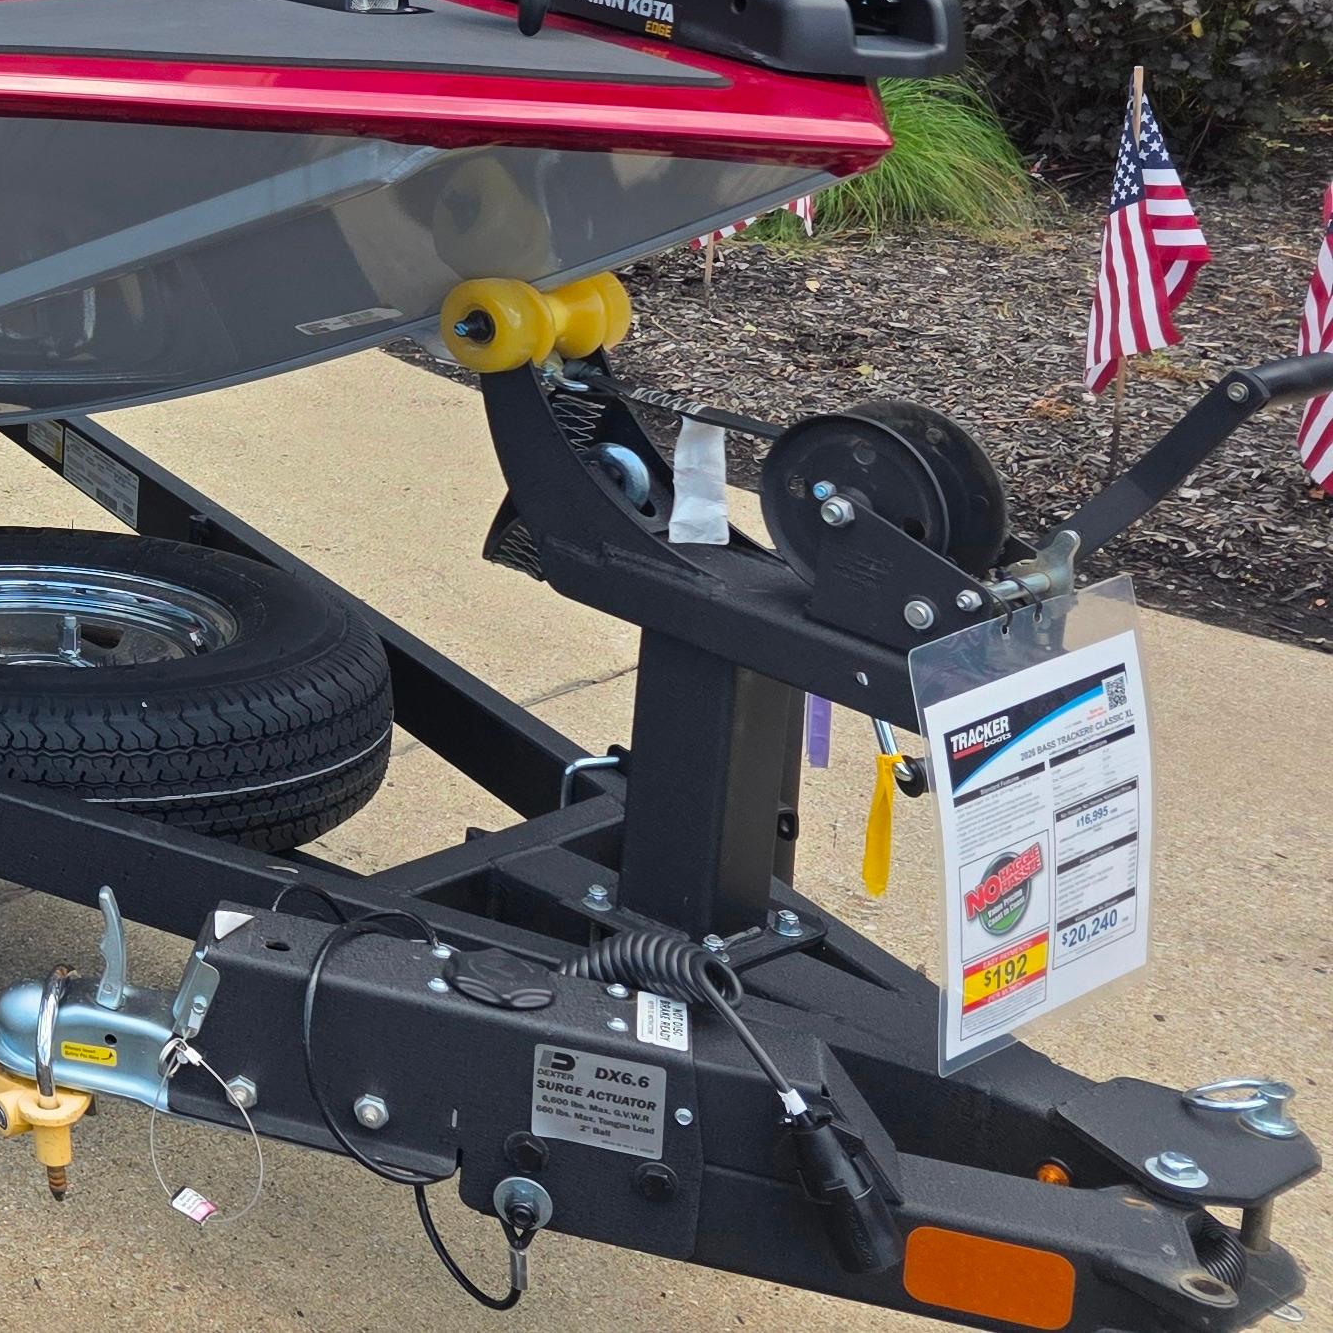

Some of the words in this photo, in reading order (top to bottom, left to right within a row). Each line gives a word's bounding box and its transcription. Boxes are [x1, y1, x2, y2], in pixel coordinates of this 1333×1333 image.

[645, 20, 673, 38] EDGE
[950, 715, 1010, 753] TRACKER
[984, 732, 1012, 748] boats
[1037, 740, 1057, 754] BASS
[1095, 713, 1124, 730] CLASSIC
[1125, 709, 1134, 719] XL
[964, 875, 1002, 921] NO
[1000, 843, 1040, 879] HAGGLE
[1001, 857, 1042, 893] HASSLE
[1061, 909, 1118, 947] $20,240
[984, 953, 1028, 989] $192
[660, 1000, 671, 1020] BRAKE
[536, 1068, 574, 1082] DEXTER
[595, 1067, 651, 1088] DX6.6
[536, 1079, 584, 1096] SURGE
[586, 1089, 657, 1111] ACTUATOR
[589, 1104, 612, 1115] Max.
[574, 1112, 596, 1123] Max.
[598, 1116, 631, 1131] Tongue
[633, 1123, 655, 1135] Load
